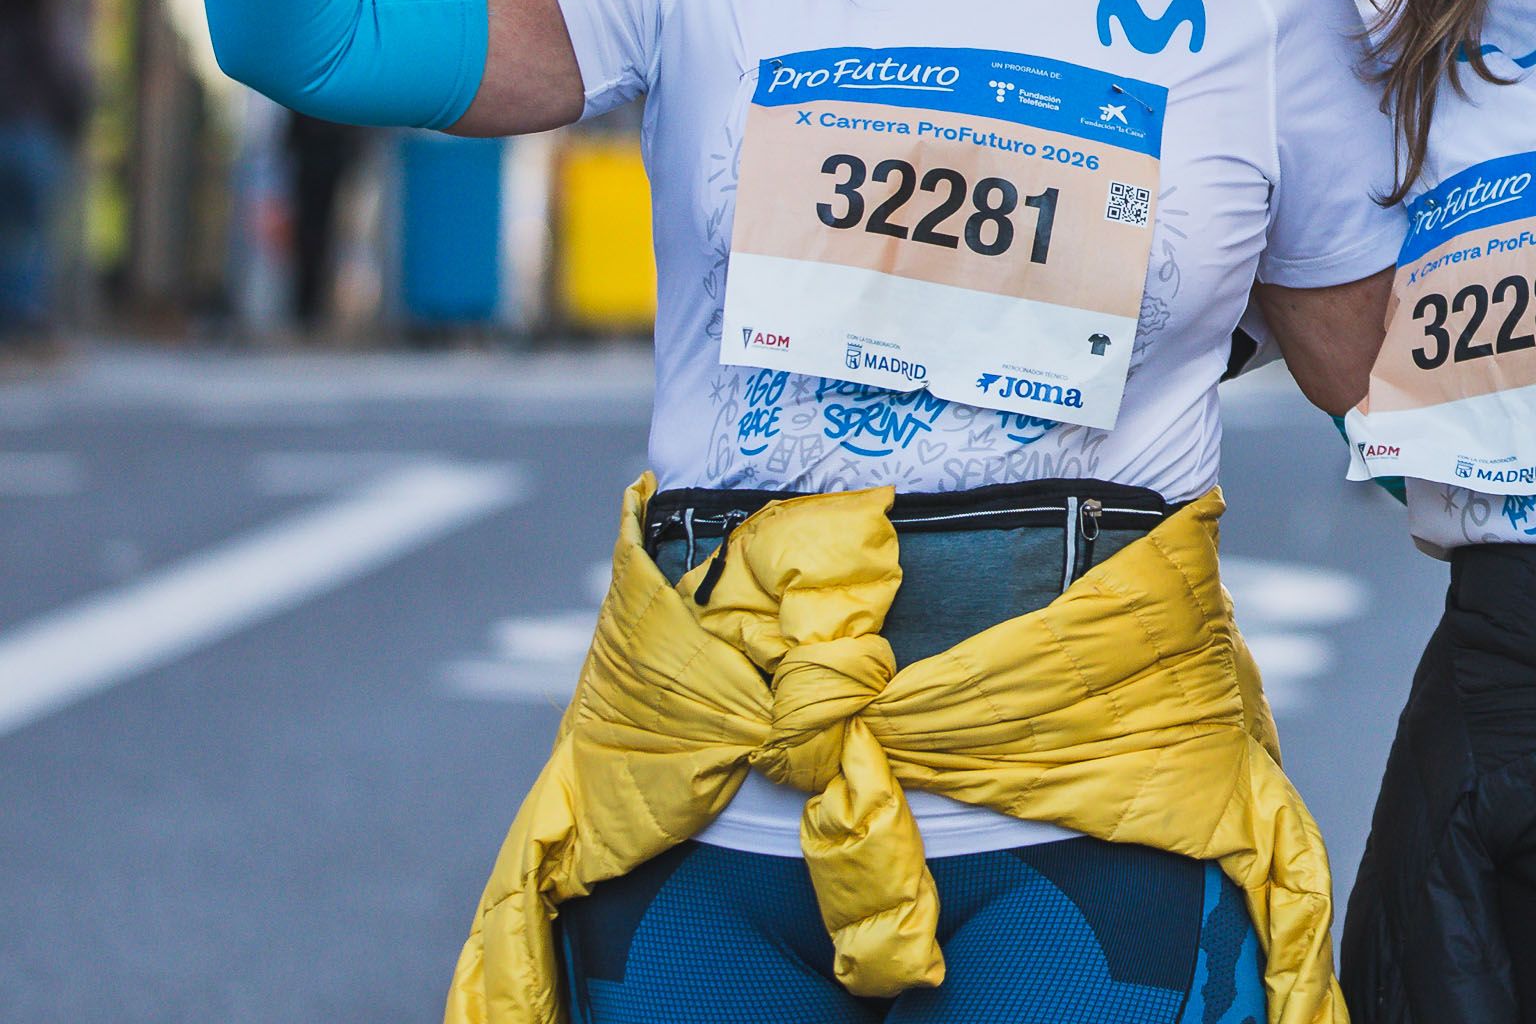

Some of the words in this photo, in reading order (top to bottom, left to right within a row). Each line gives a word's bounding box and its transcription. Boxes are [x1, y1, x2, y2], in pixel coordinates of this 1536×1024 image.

[768, 57, 960, 92] ProFuturo
[1004, 64, 1049, 77] PROGRAMA
[1018, 96, 1060, 111] Telefónica
[1019, 89, 1061, 104] Fundación
[796, 110, 814, 126] X
[819, 112, 911, 135] Carrera
[917, 121, 1037, 156] ProFuturo
[1041, 144, 1100, 171] 2026
[816, 153, 1060, 265] 32281
[1407, 268, 1419, 287] X
[1420, 247, 1482, 278] Carrera
[753, 332, 790, 349] ADM
[864, 353, 926, 381] MADRID
[737, 406, 783, 443] RACE
[1366, 444, 1400, 457] ADM
